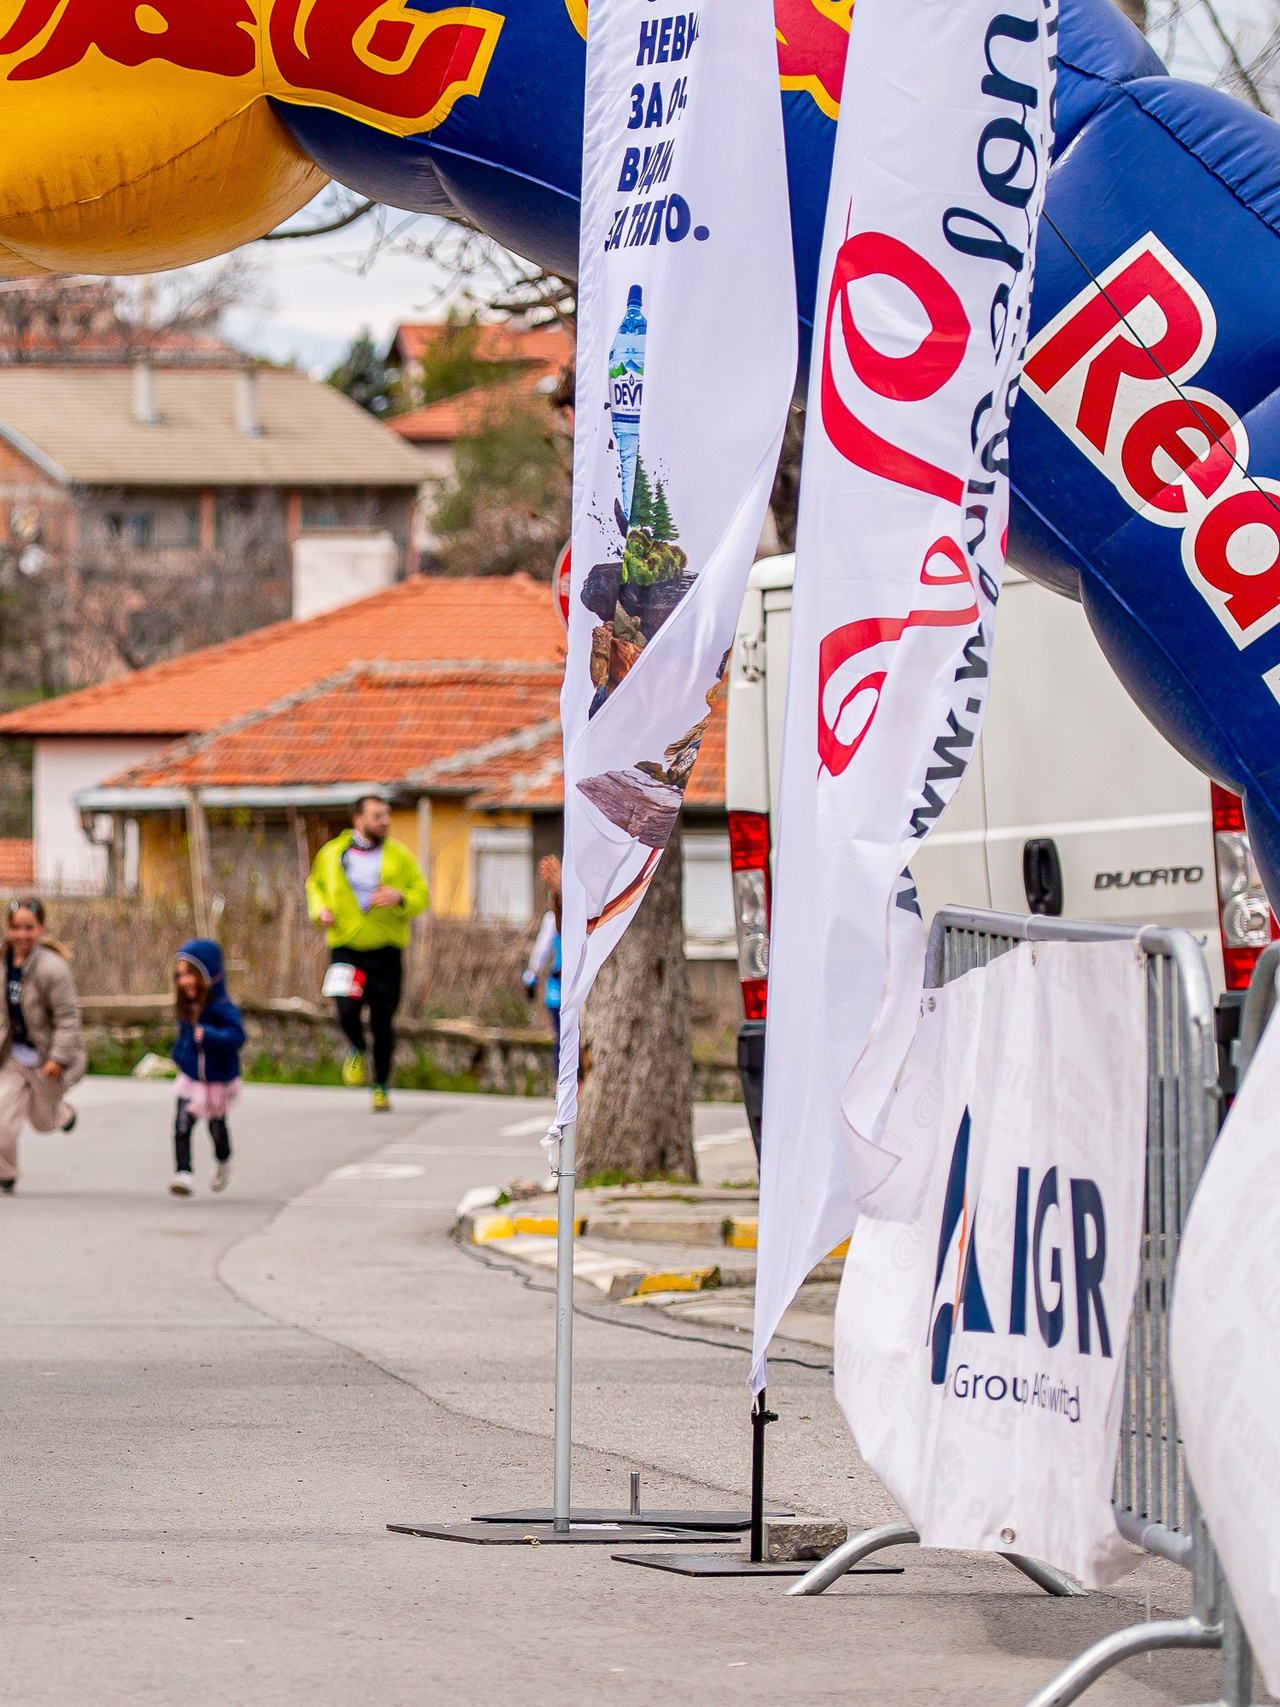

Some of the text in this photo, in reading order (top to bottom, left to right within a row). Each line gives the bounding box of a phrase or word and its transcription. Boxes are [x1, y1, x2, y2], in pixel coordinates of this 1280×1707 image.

[627, 82, 663, 129] ЗА
[614, 383, 644, 408] DEVI
[1094, 866, 1203, 890] DUCATO
[954, 1364, 1029, 1412] Group
